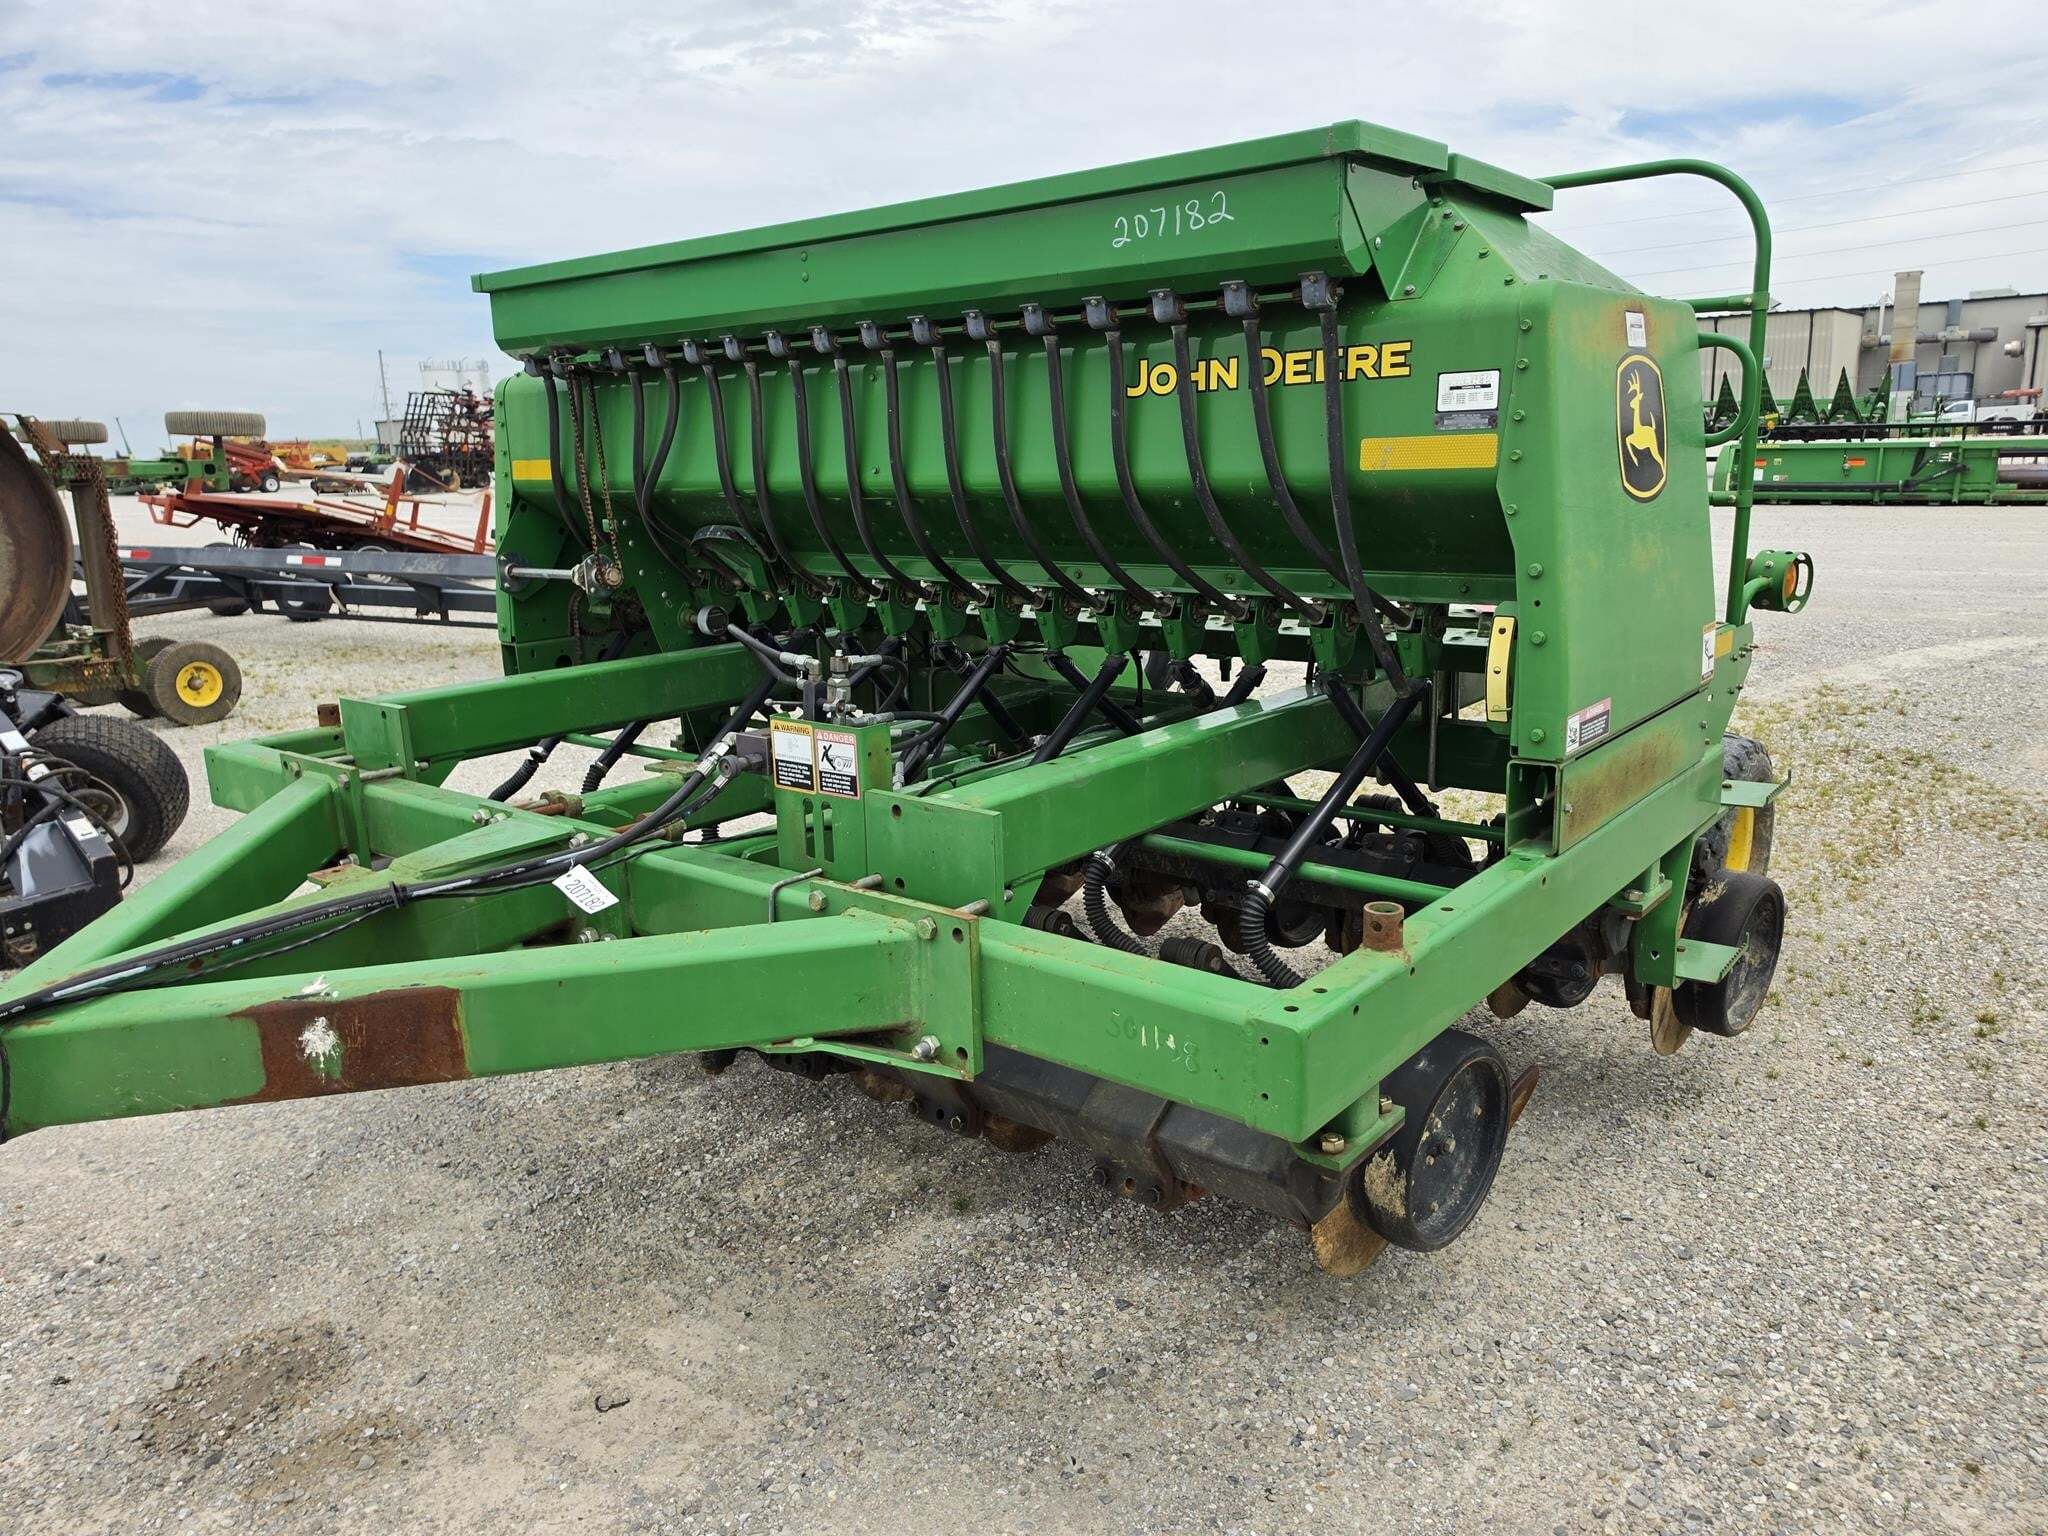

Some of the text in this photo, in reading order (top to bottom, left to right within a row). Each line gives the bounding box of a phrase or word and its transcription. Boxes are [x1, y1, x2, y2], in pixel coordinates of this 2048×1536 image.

[1111, 190, 1235, 248] 207182
[781, 724, 810, 735] WARNING
[823, 732, 854, 744] DANGER
[565, 879, 606, 911] 207182
